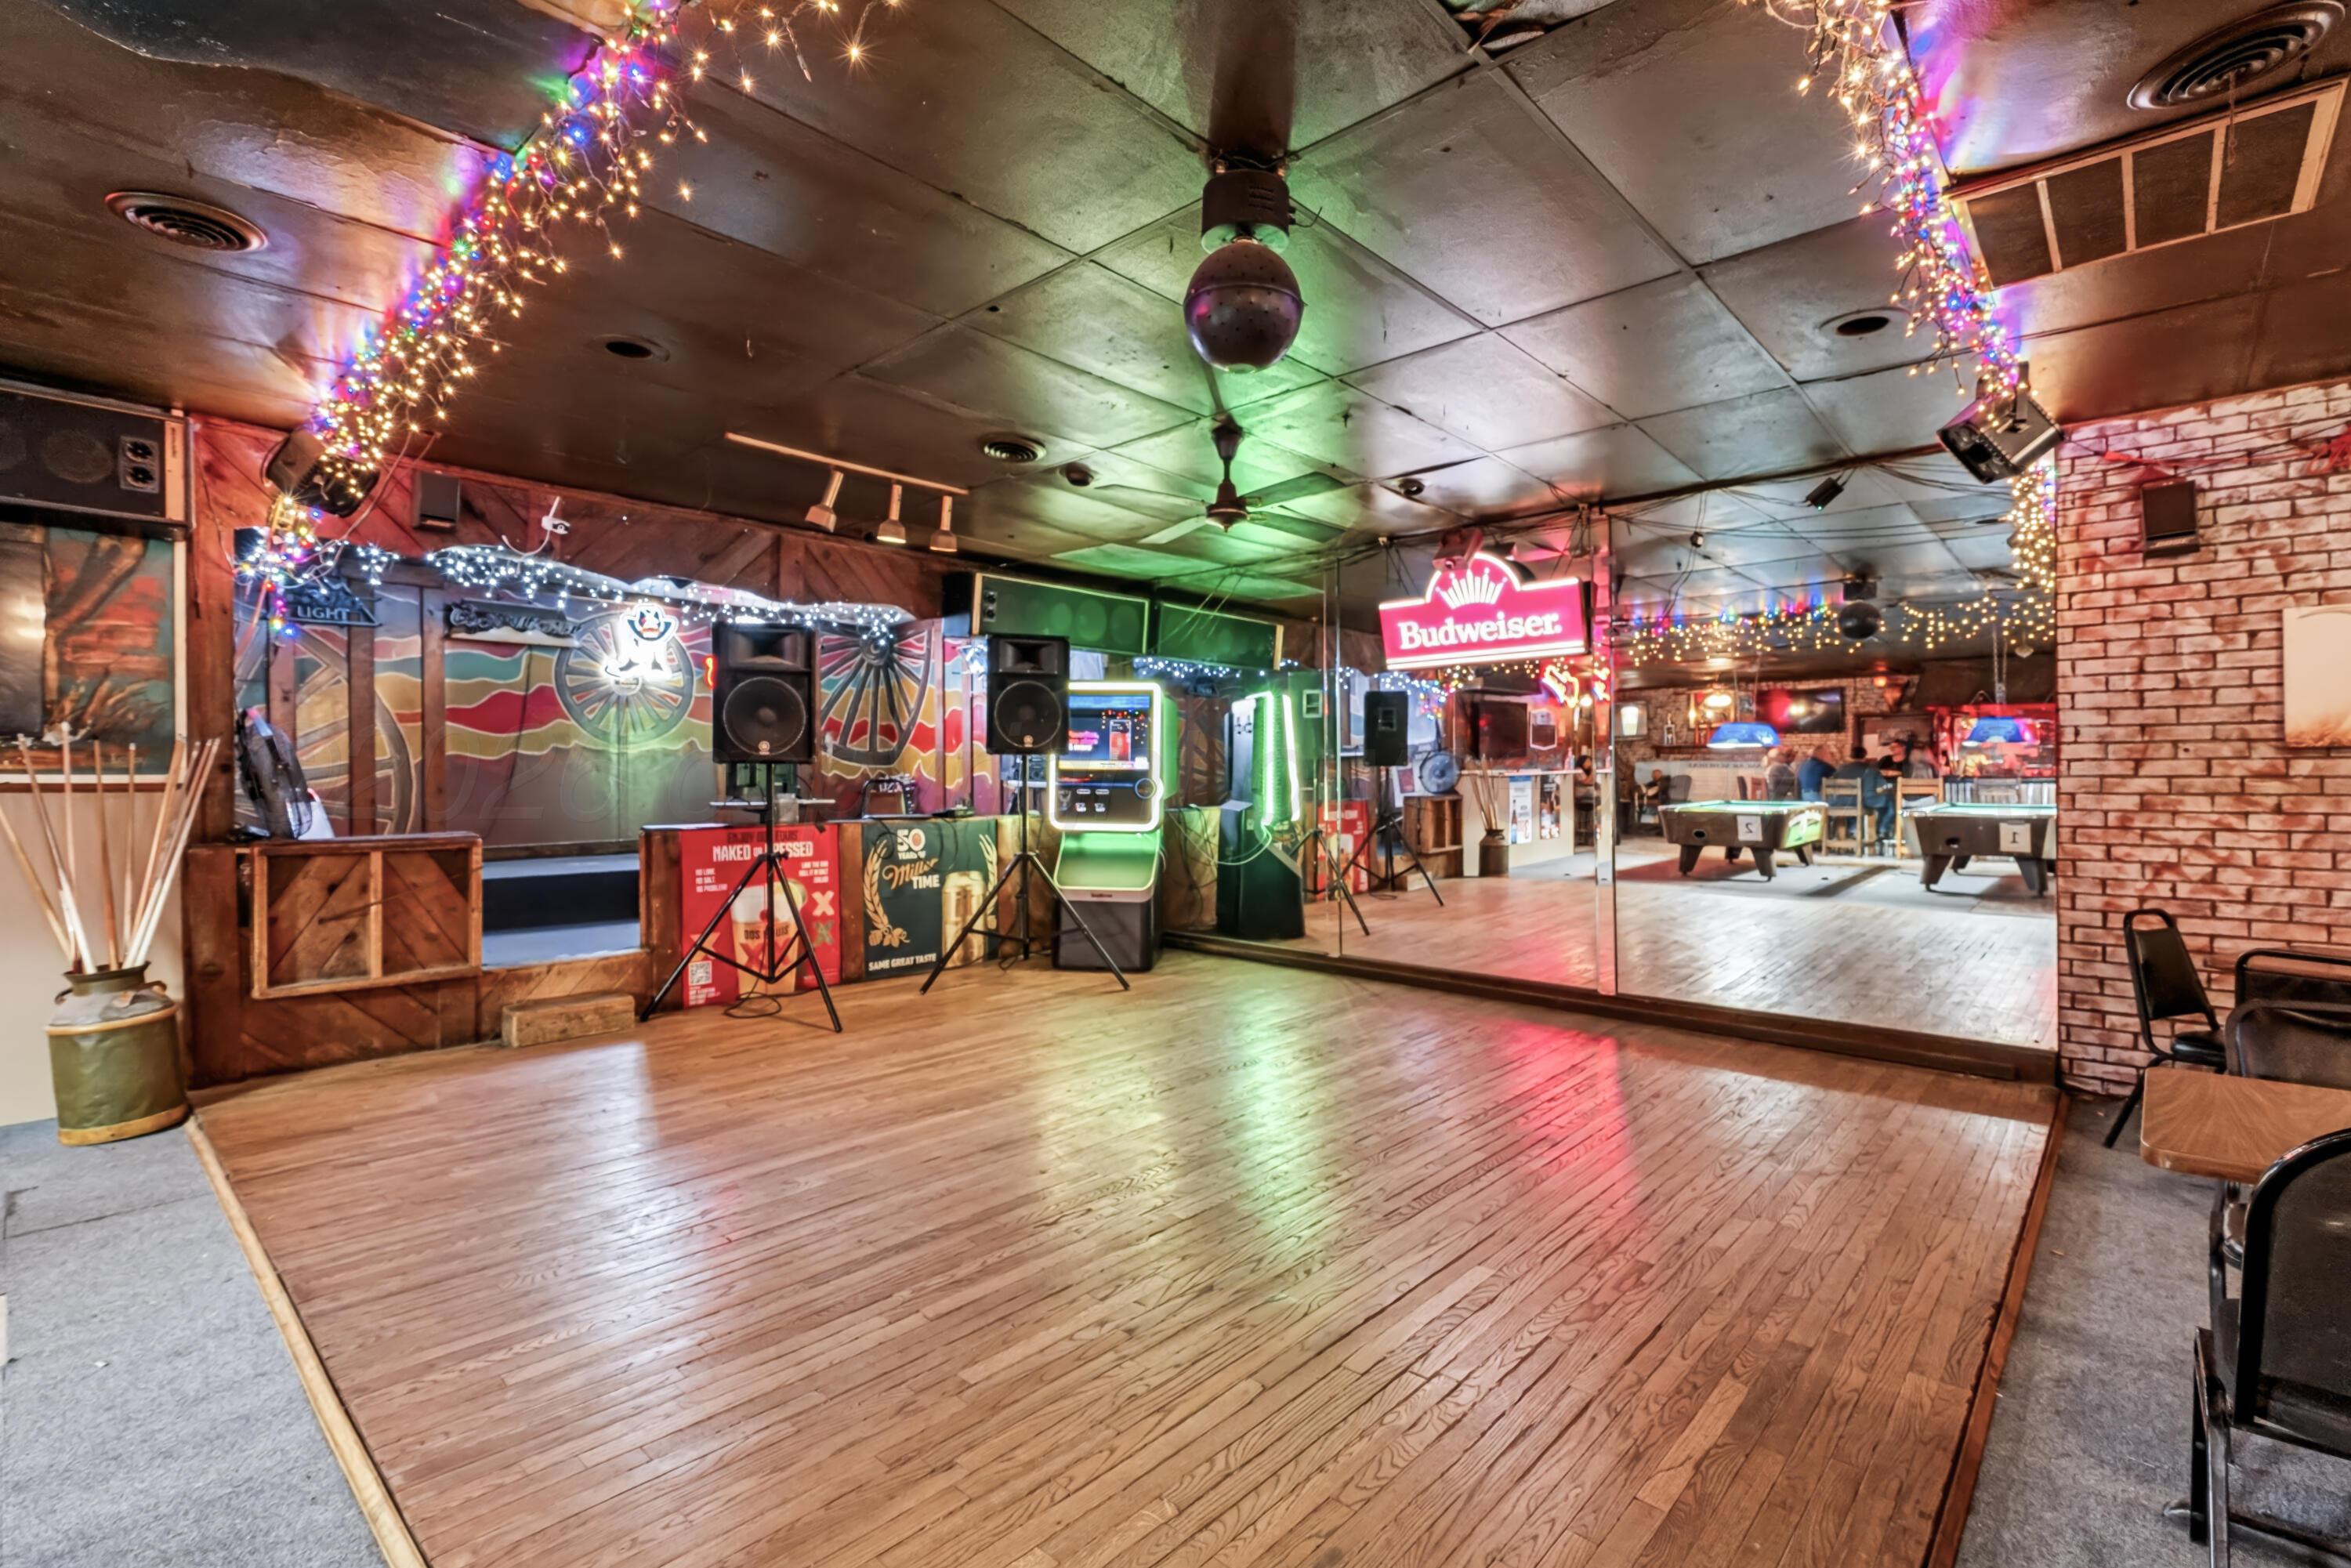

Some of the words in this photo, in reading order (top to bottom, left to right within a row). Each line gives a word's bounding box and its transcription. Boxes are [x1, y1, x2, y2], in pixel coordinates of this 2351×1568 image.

[297, 606, 350, 621] LIGHT
[897, 828, 926, 852] 50
[712, 844, 752, 862] NAKED
[765, 841, 813, 859] RESSED
[911, 875, 940, 889] TIME
[868, 960, 890, 971] SAME
[891, 957, 915, 968] GREAT
[915, 953, 936, 964] TASTE
